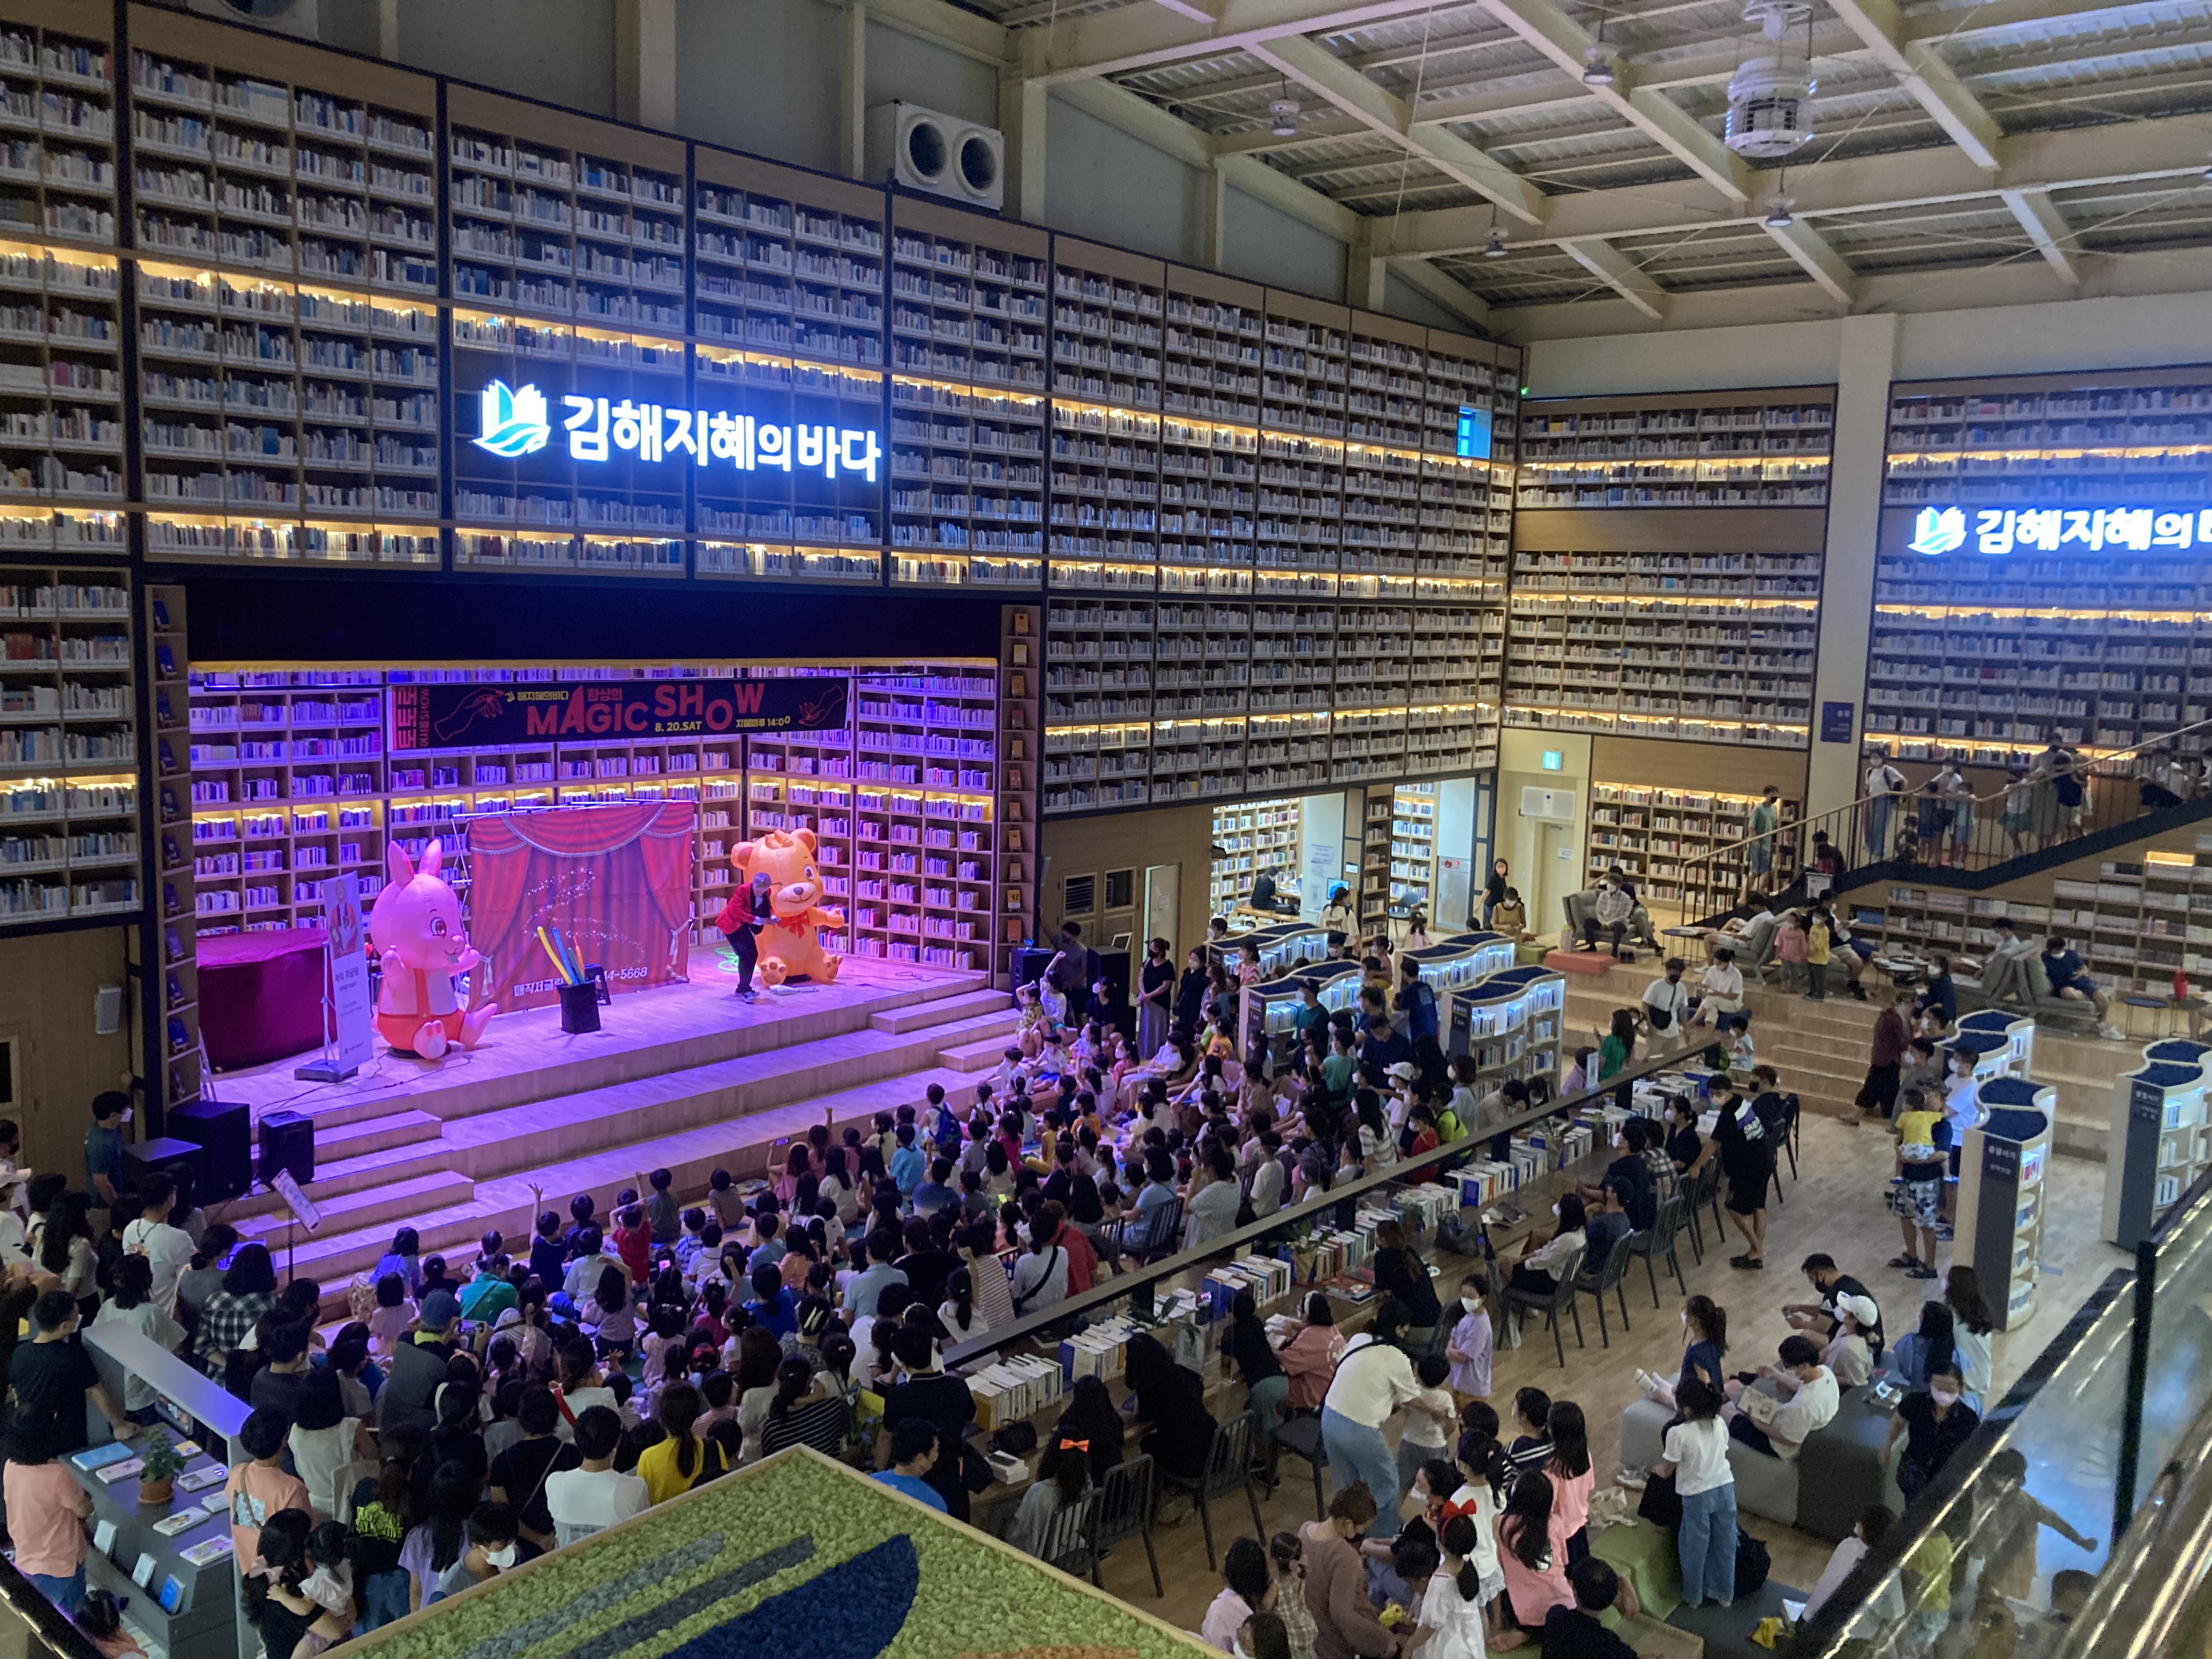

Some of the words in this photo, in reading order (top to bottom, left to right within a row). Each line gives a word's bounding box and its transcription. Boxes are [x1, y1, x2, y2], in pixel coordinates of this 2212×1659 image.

[563, 395, 881, 482] 김해지혜의바다
[527, 685, 649, 735] MAGIC
[654, 684, 765, 731] SHOW
[768, 715, 791, 727] 14:00
